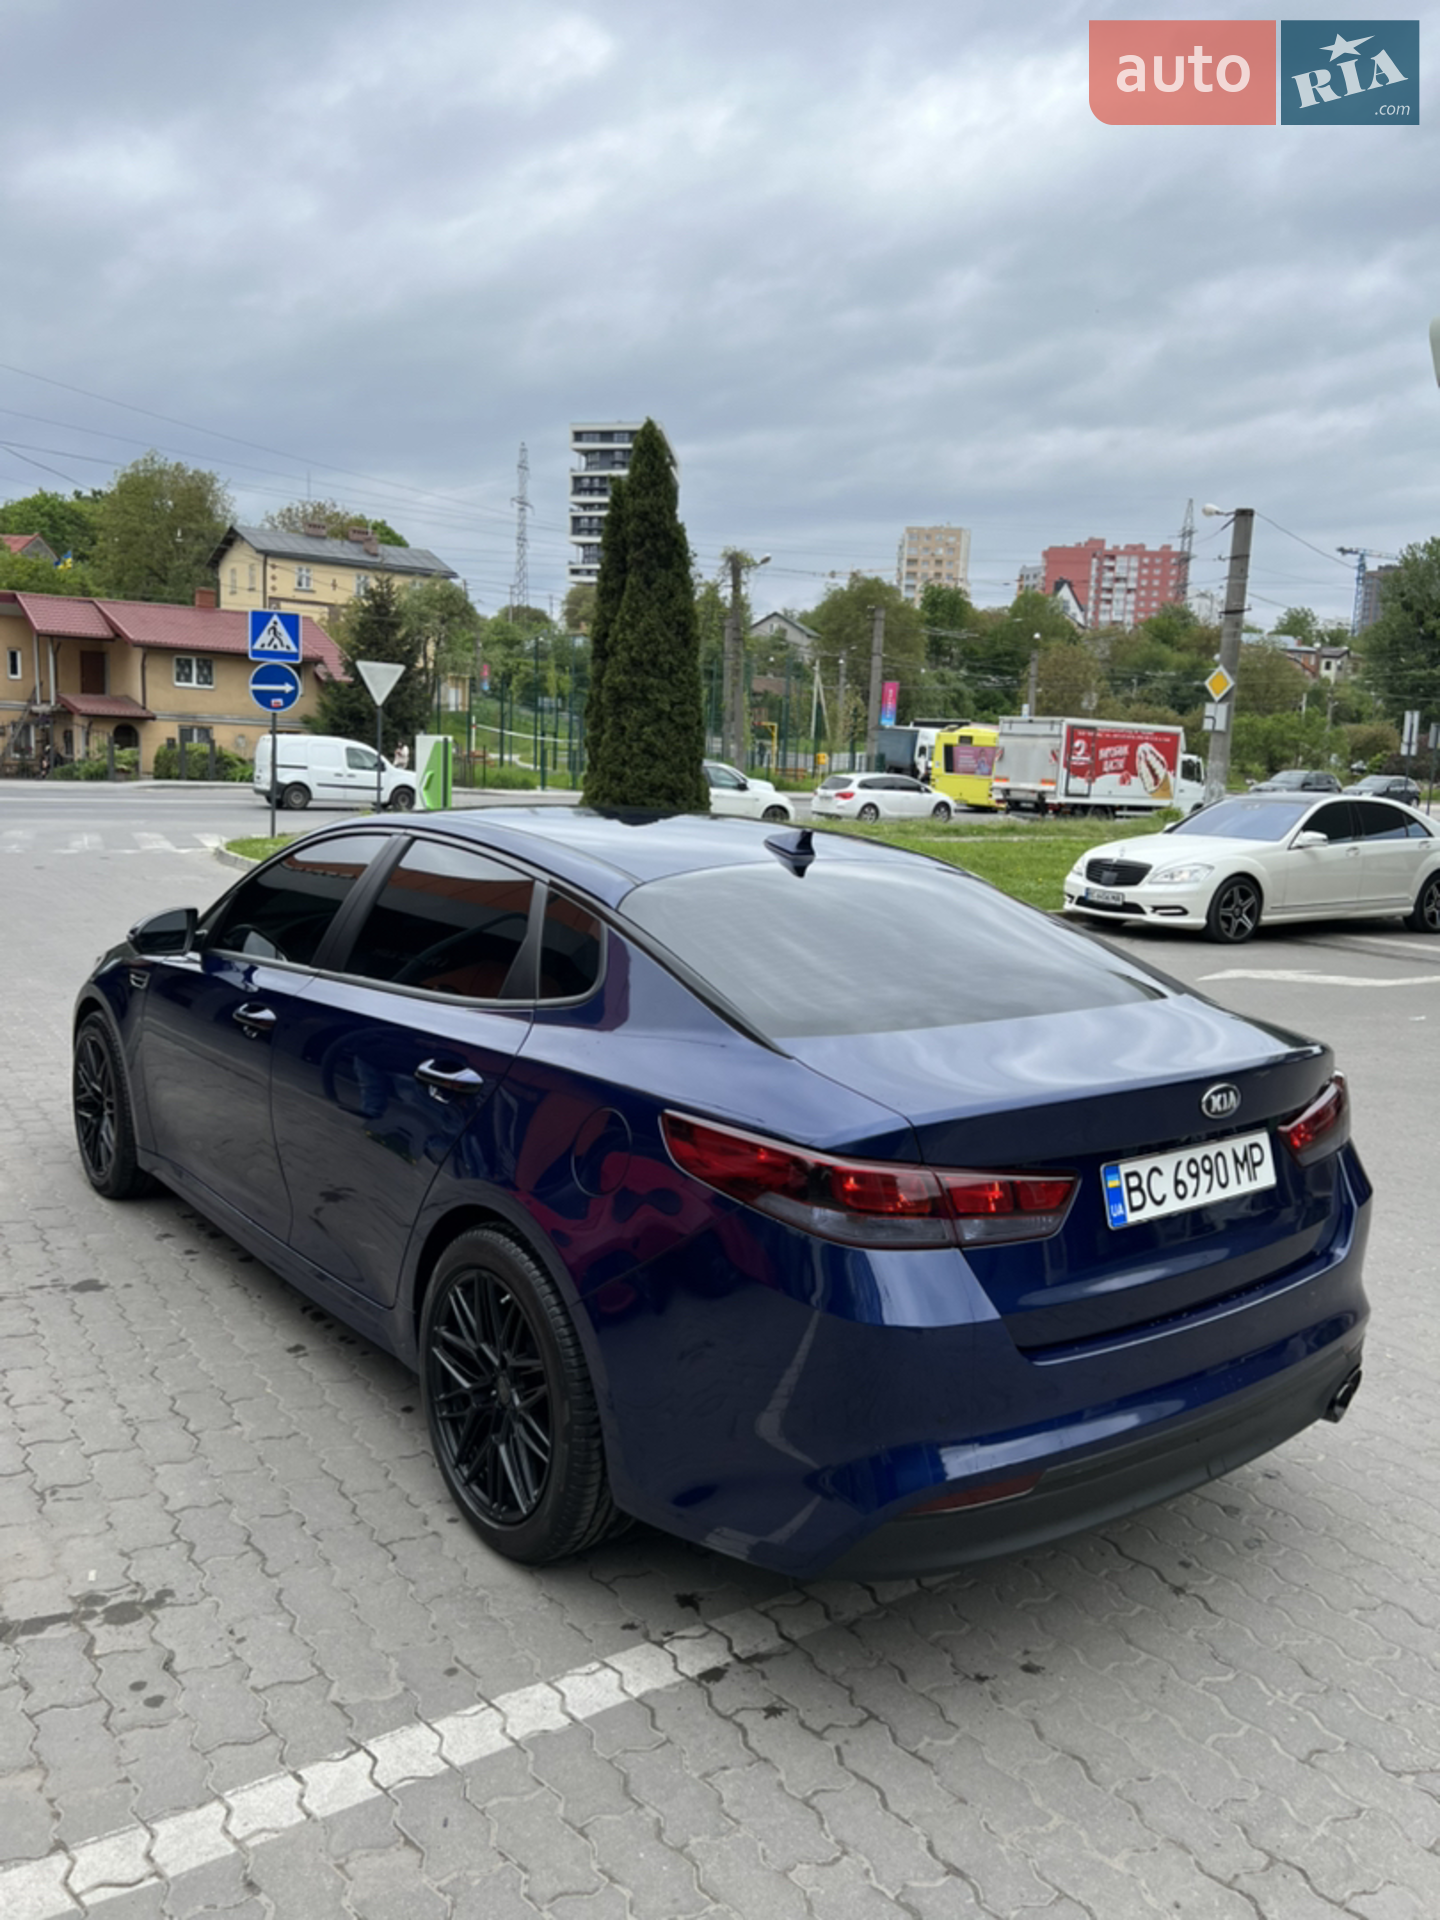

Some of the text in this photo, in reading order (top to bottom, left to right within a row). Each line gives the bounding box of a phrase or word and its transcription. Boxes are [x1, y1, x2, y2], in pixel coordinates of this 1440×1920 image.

[1210, 1090, 1238, 1113] KIA
[1124, 1142, 1265, 1213] BC 6990 MP
[1110, 1203, 1124, 1216] UA
